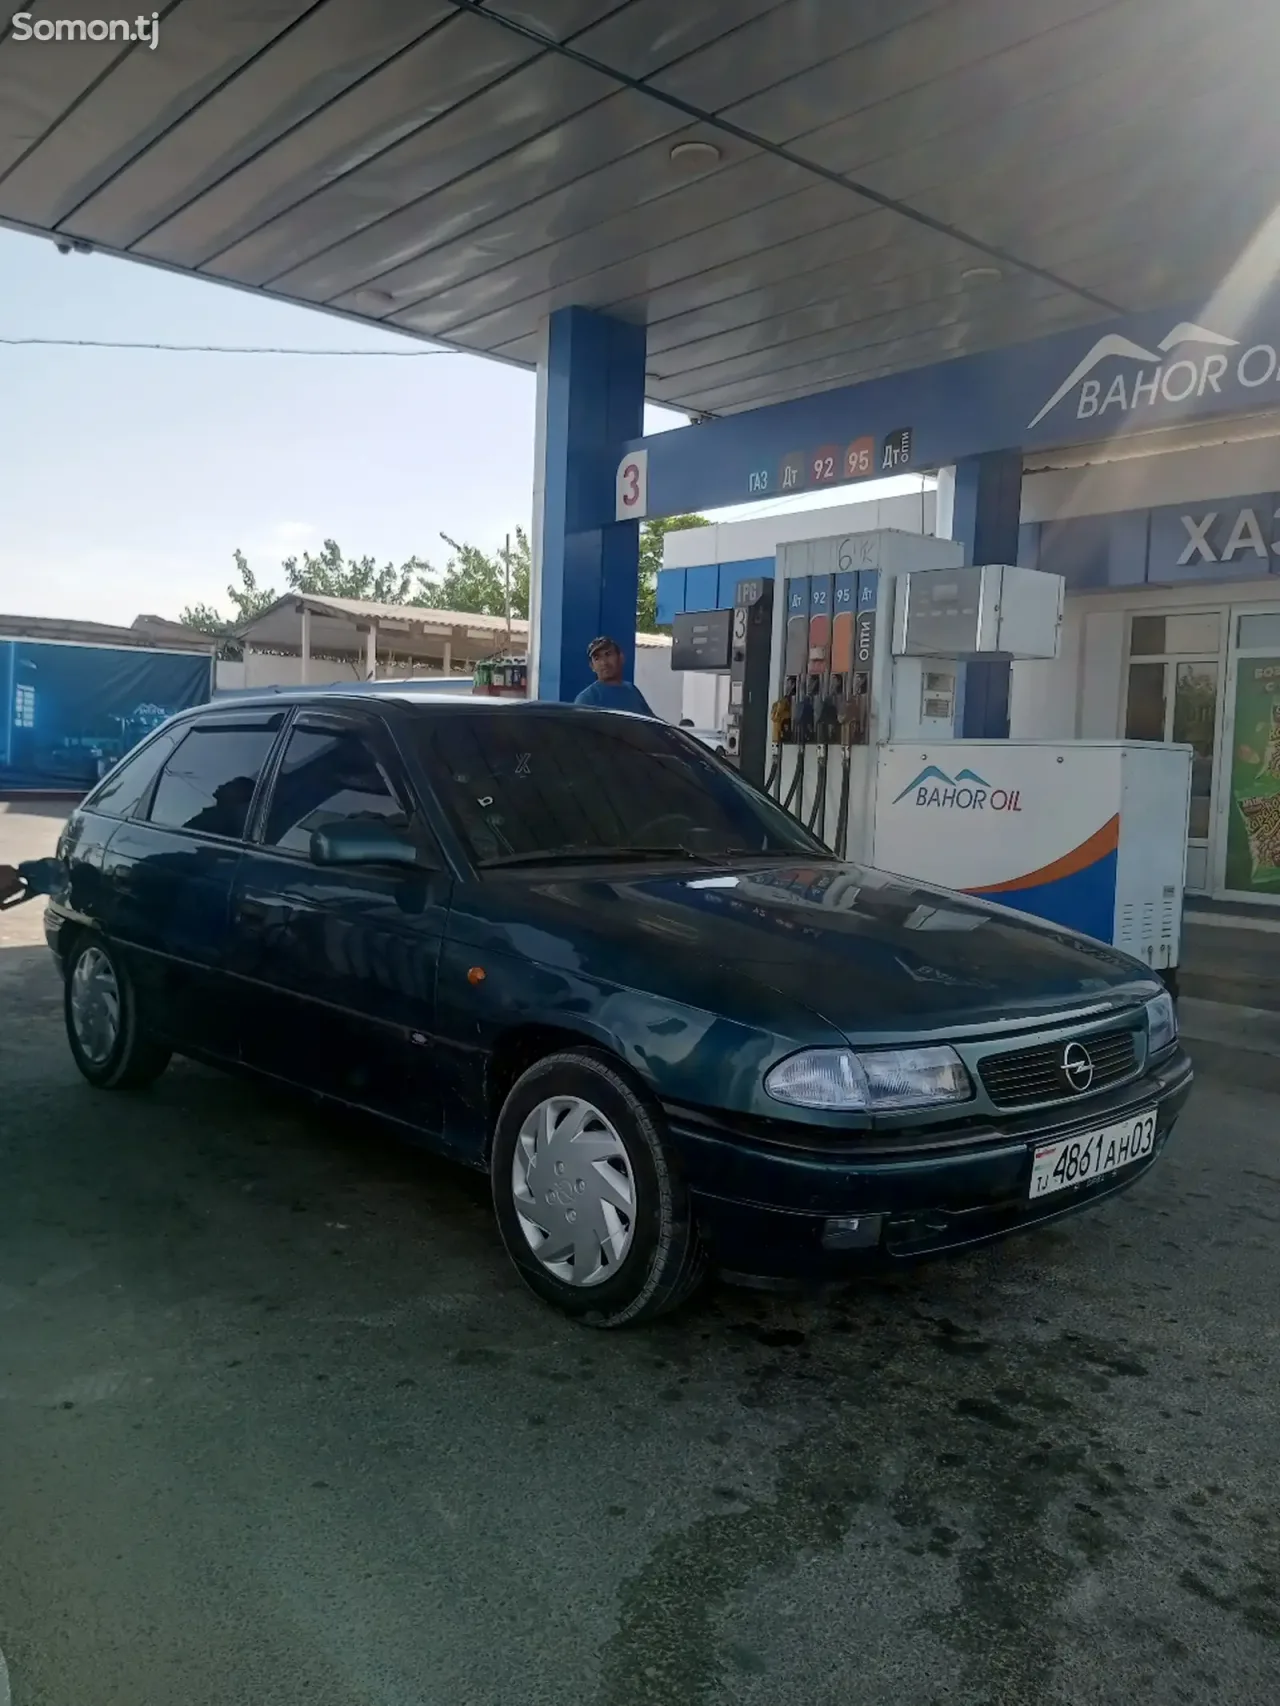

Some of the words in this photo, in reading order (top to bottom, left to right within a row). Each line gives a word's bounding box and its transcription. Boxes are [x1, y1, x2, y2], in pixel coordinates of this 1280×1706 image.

[1077, 354, 1228, 419] BAHOR
[814, 456, 834, 480] 92
[848, 449, 869, 473] 95
[623, 464, 639, 506] 3
[749, 470, 768, 492] ГАЗ
[1176, 507, 1280, 565] ХА
[813, 591, 826, 605] 92
[836, 588, 850, 603] 95
[735, 610, 746, 639] 3
[916, 787, 987, 809] BAHOR
[990, 789, 1022, 812] OIL
[1037, 1175, 1049, 1192] TJ
